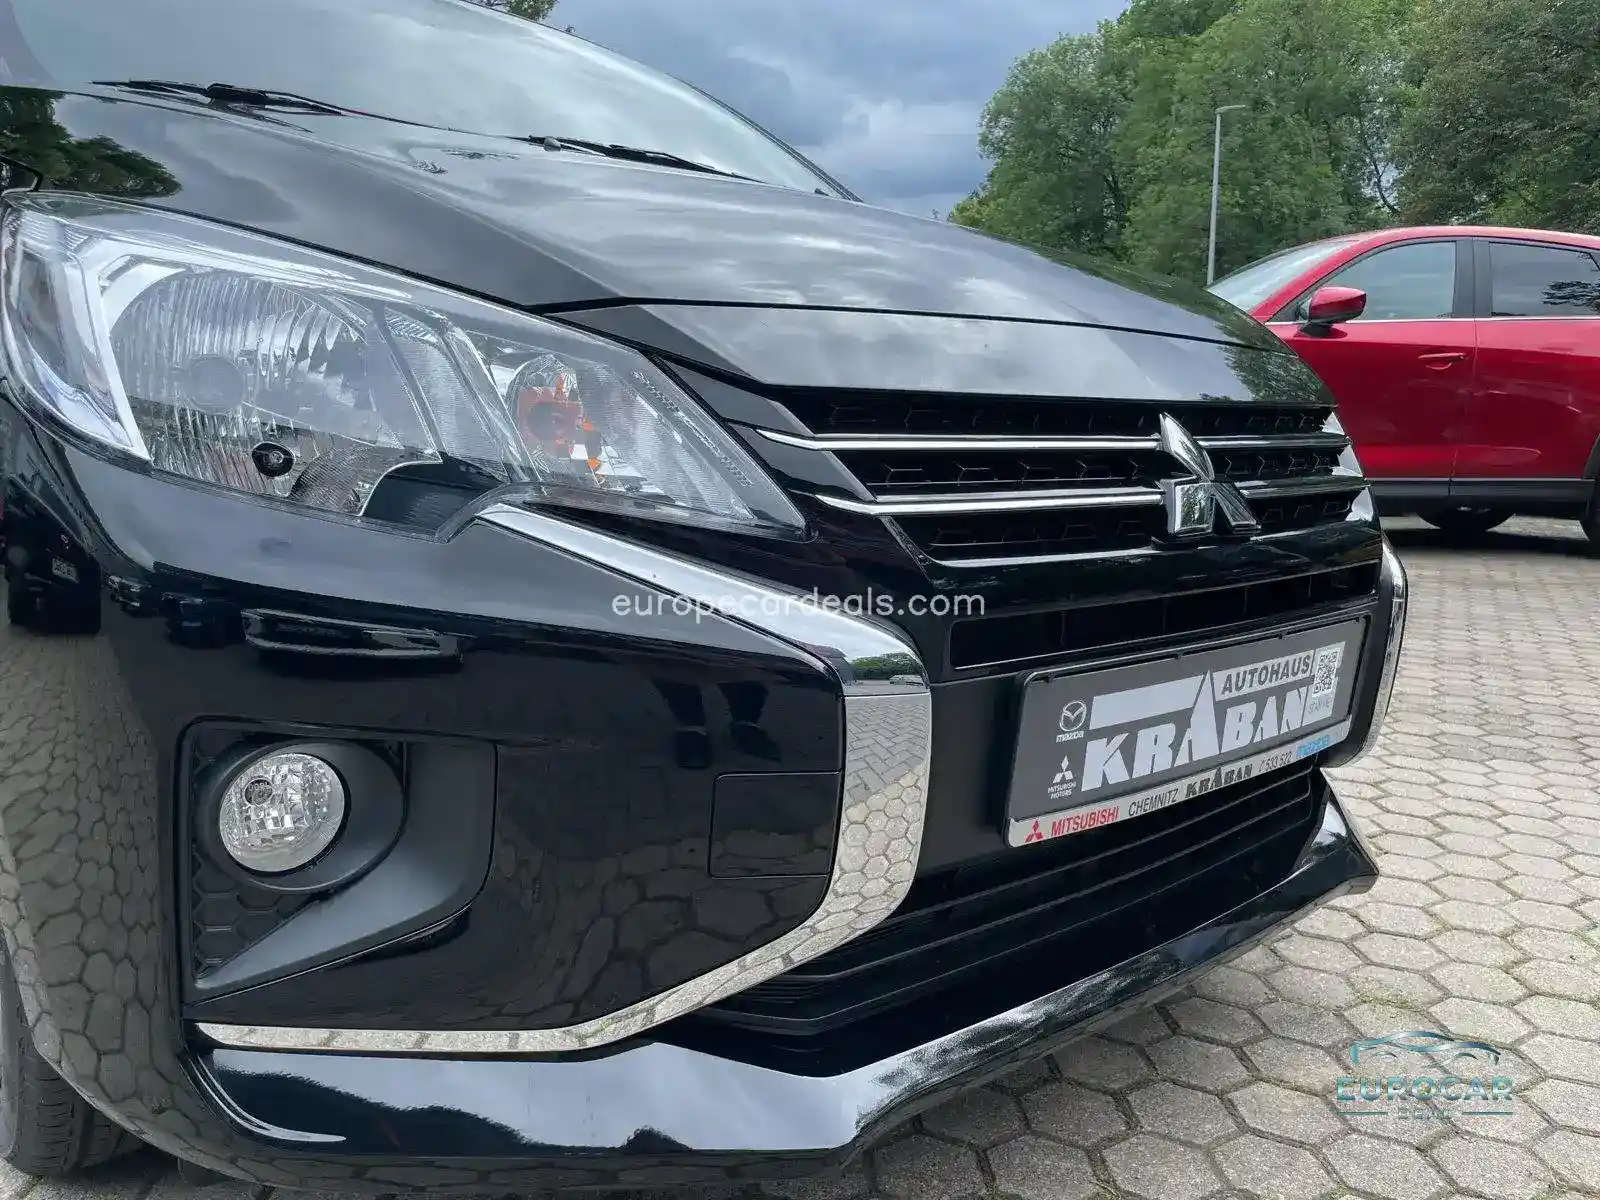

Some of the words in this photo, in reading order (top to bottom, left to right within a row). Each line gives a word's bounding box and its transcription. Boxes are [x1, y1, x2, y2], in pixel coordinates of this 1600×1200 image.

[1221, 654, 1311, 696] AUTOHAUS
[1056, 731, 1085, 743] mazda
[1082, 670, 1308, 791] KRABAN
[1048, 781, 1077, 794] MITSUBISHI
[1050, 789, 1073, 800] MOTORS
[1051, 806, 1120, 837] MITSUBISHI
[1128, 788, 1179, 817] CHEMNITZ
[1185, 766, 1253, 799] KRABAN
